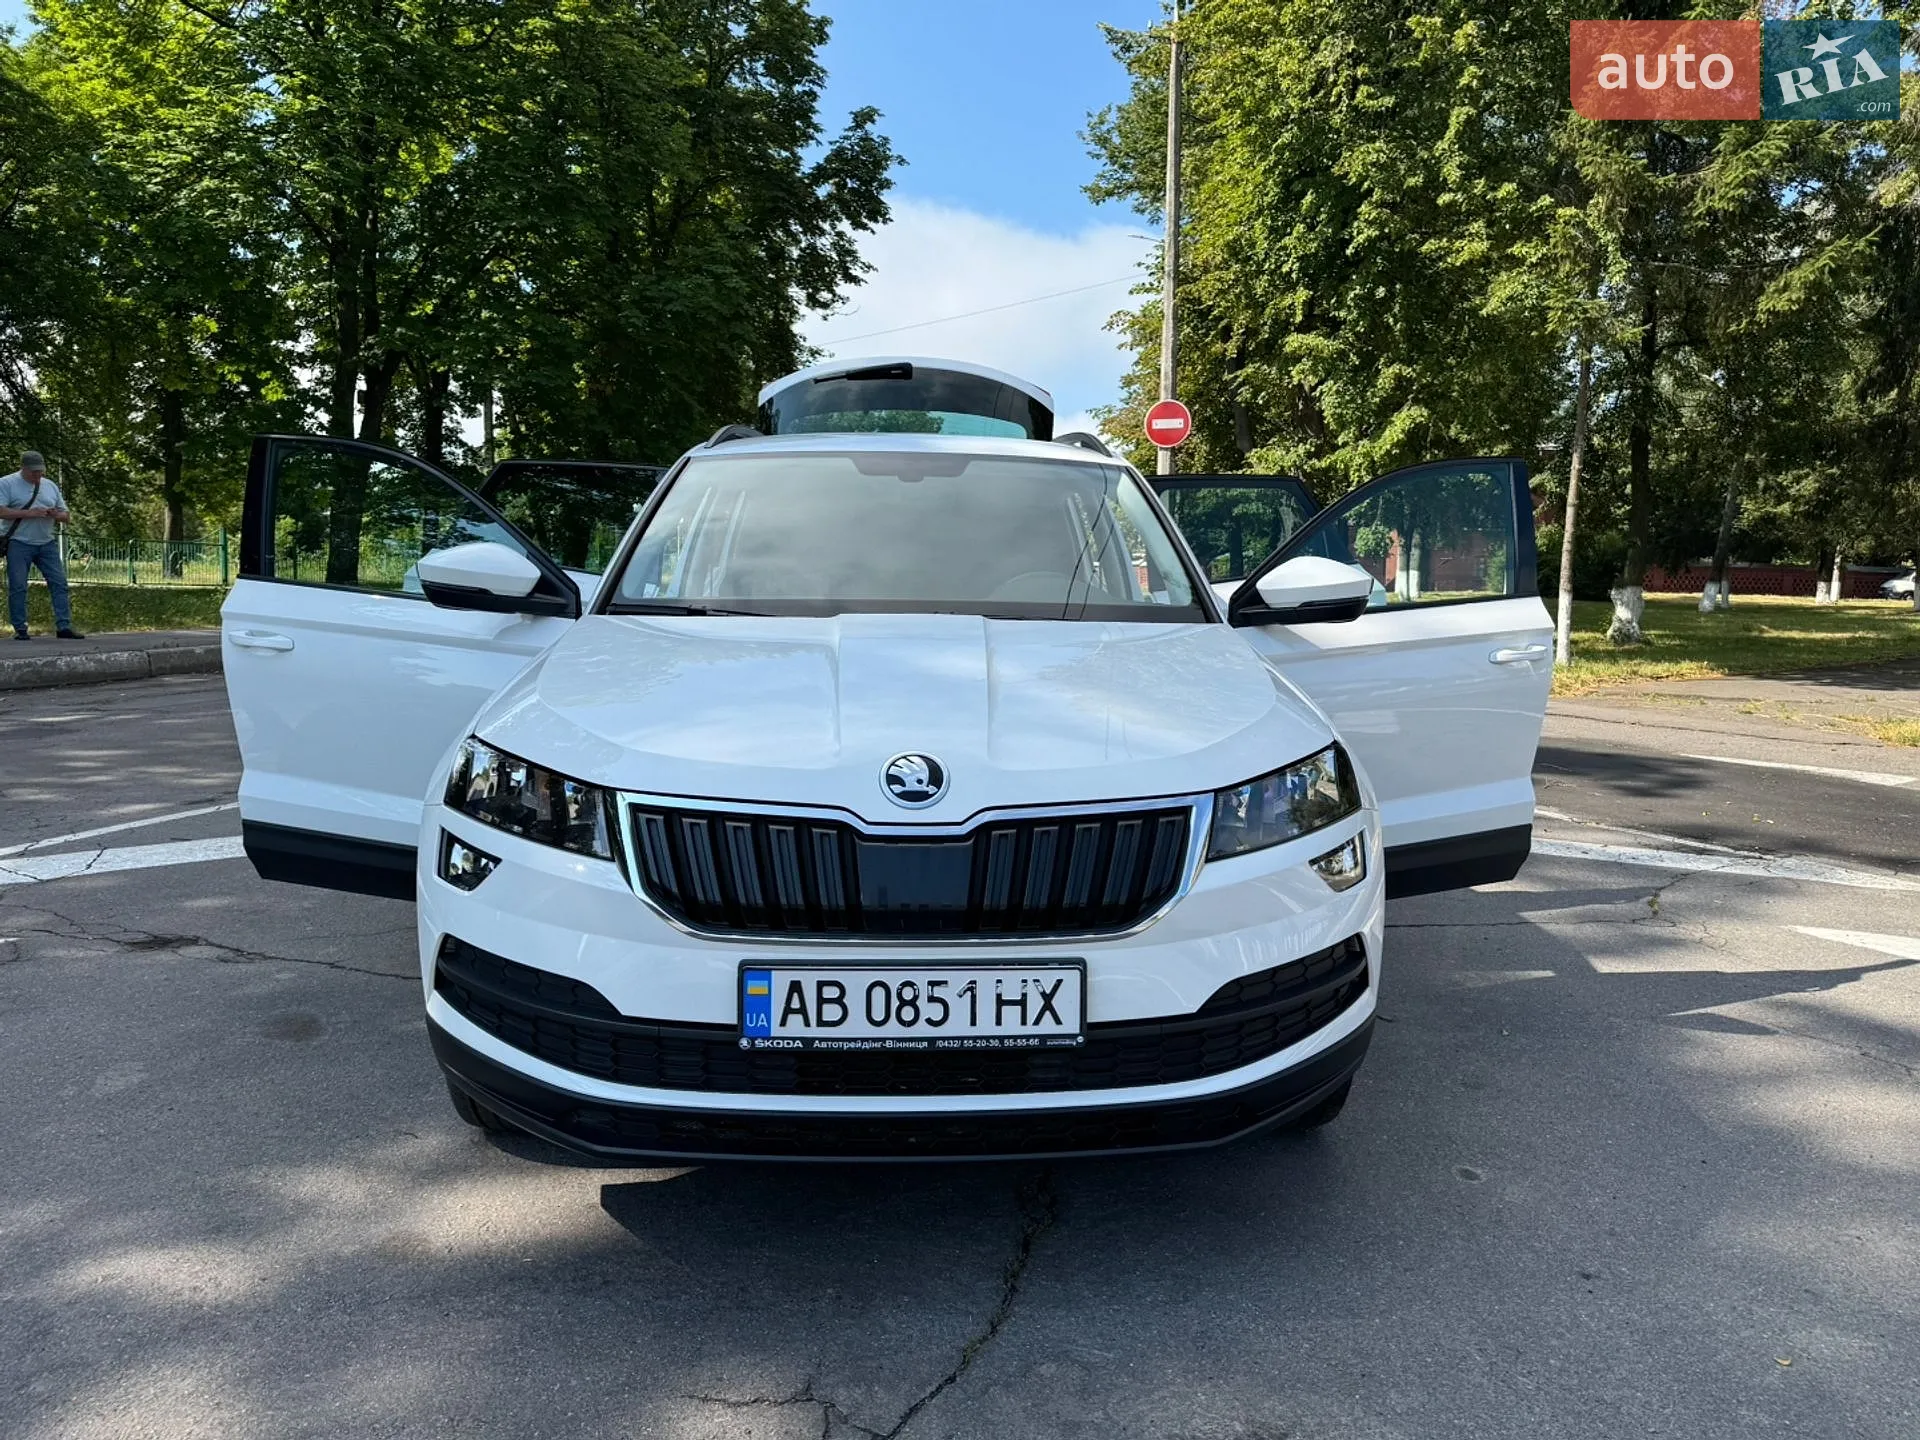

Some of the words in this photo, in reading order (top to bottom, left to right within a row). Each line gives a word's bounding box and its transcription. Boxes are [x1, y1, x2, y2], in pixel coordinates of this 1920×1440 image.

[779, 980, 848, 1028] AB
[865, 980, 977, 1028] 0851
[995, 978, 1064, 1026] HX
[746, 1013, 768, 1028] UA
[754, 1037, 803, 1048] ŠKODA
